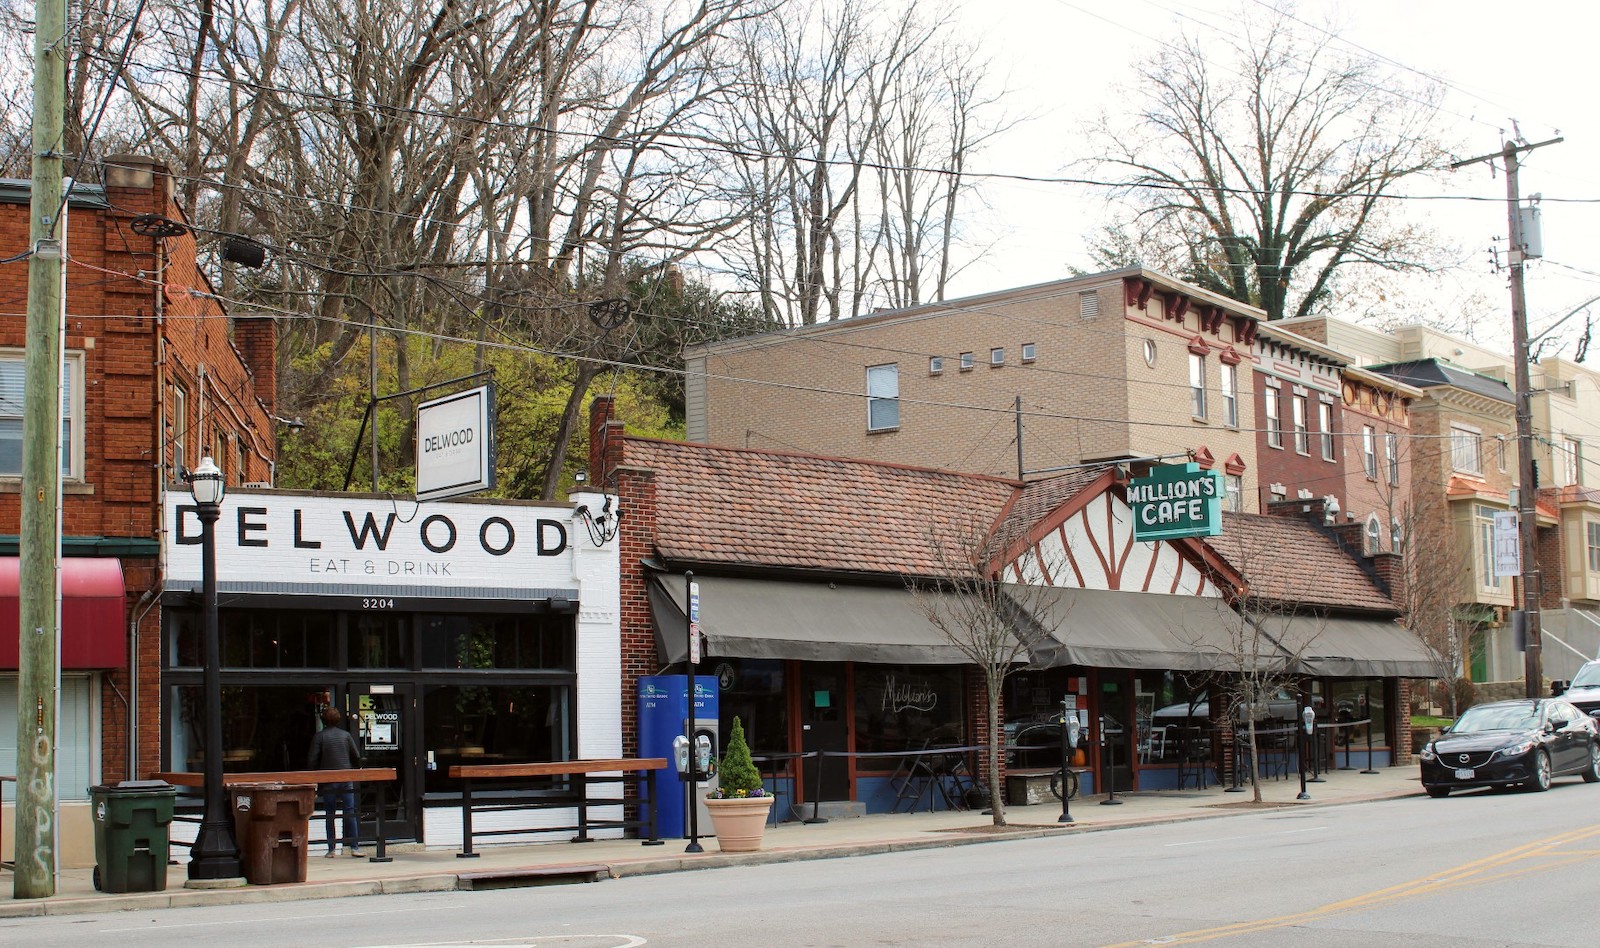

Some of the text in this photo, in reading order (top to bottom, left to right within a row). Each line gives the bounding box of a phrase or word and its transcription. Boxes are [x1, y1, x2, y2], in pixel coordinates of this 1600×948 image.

[424, 427, 474, 453] DELWOOD
[1126, 476, 1215, 504] MILLION'S
[1141, 499, 1204, 526] CAFE
[175, 503, 568, 557] DELWOOD
[310, 557, 453, 577] EAT & DRINK
[362, 598, 395, 610] 3204
